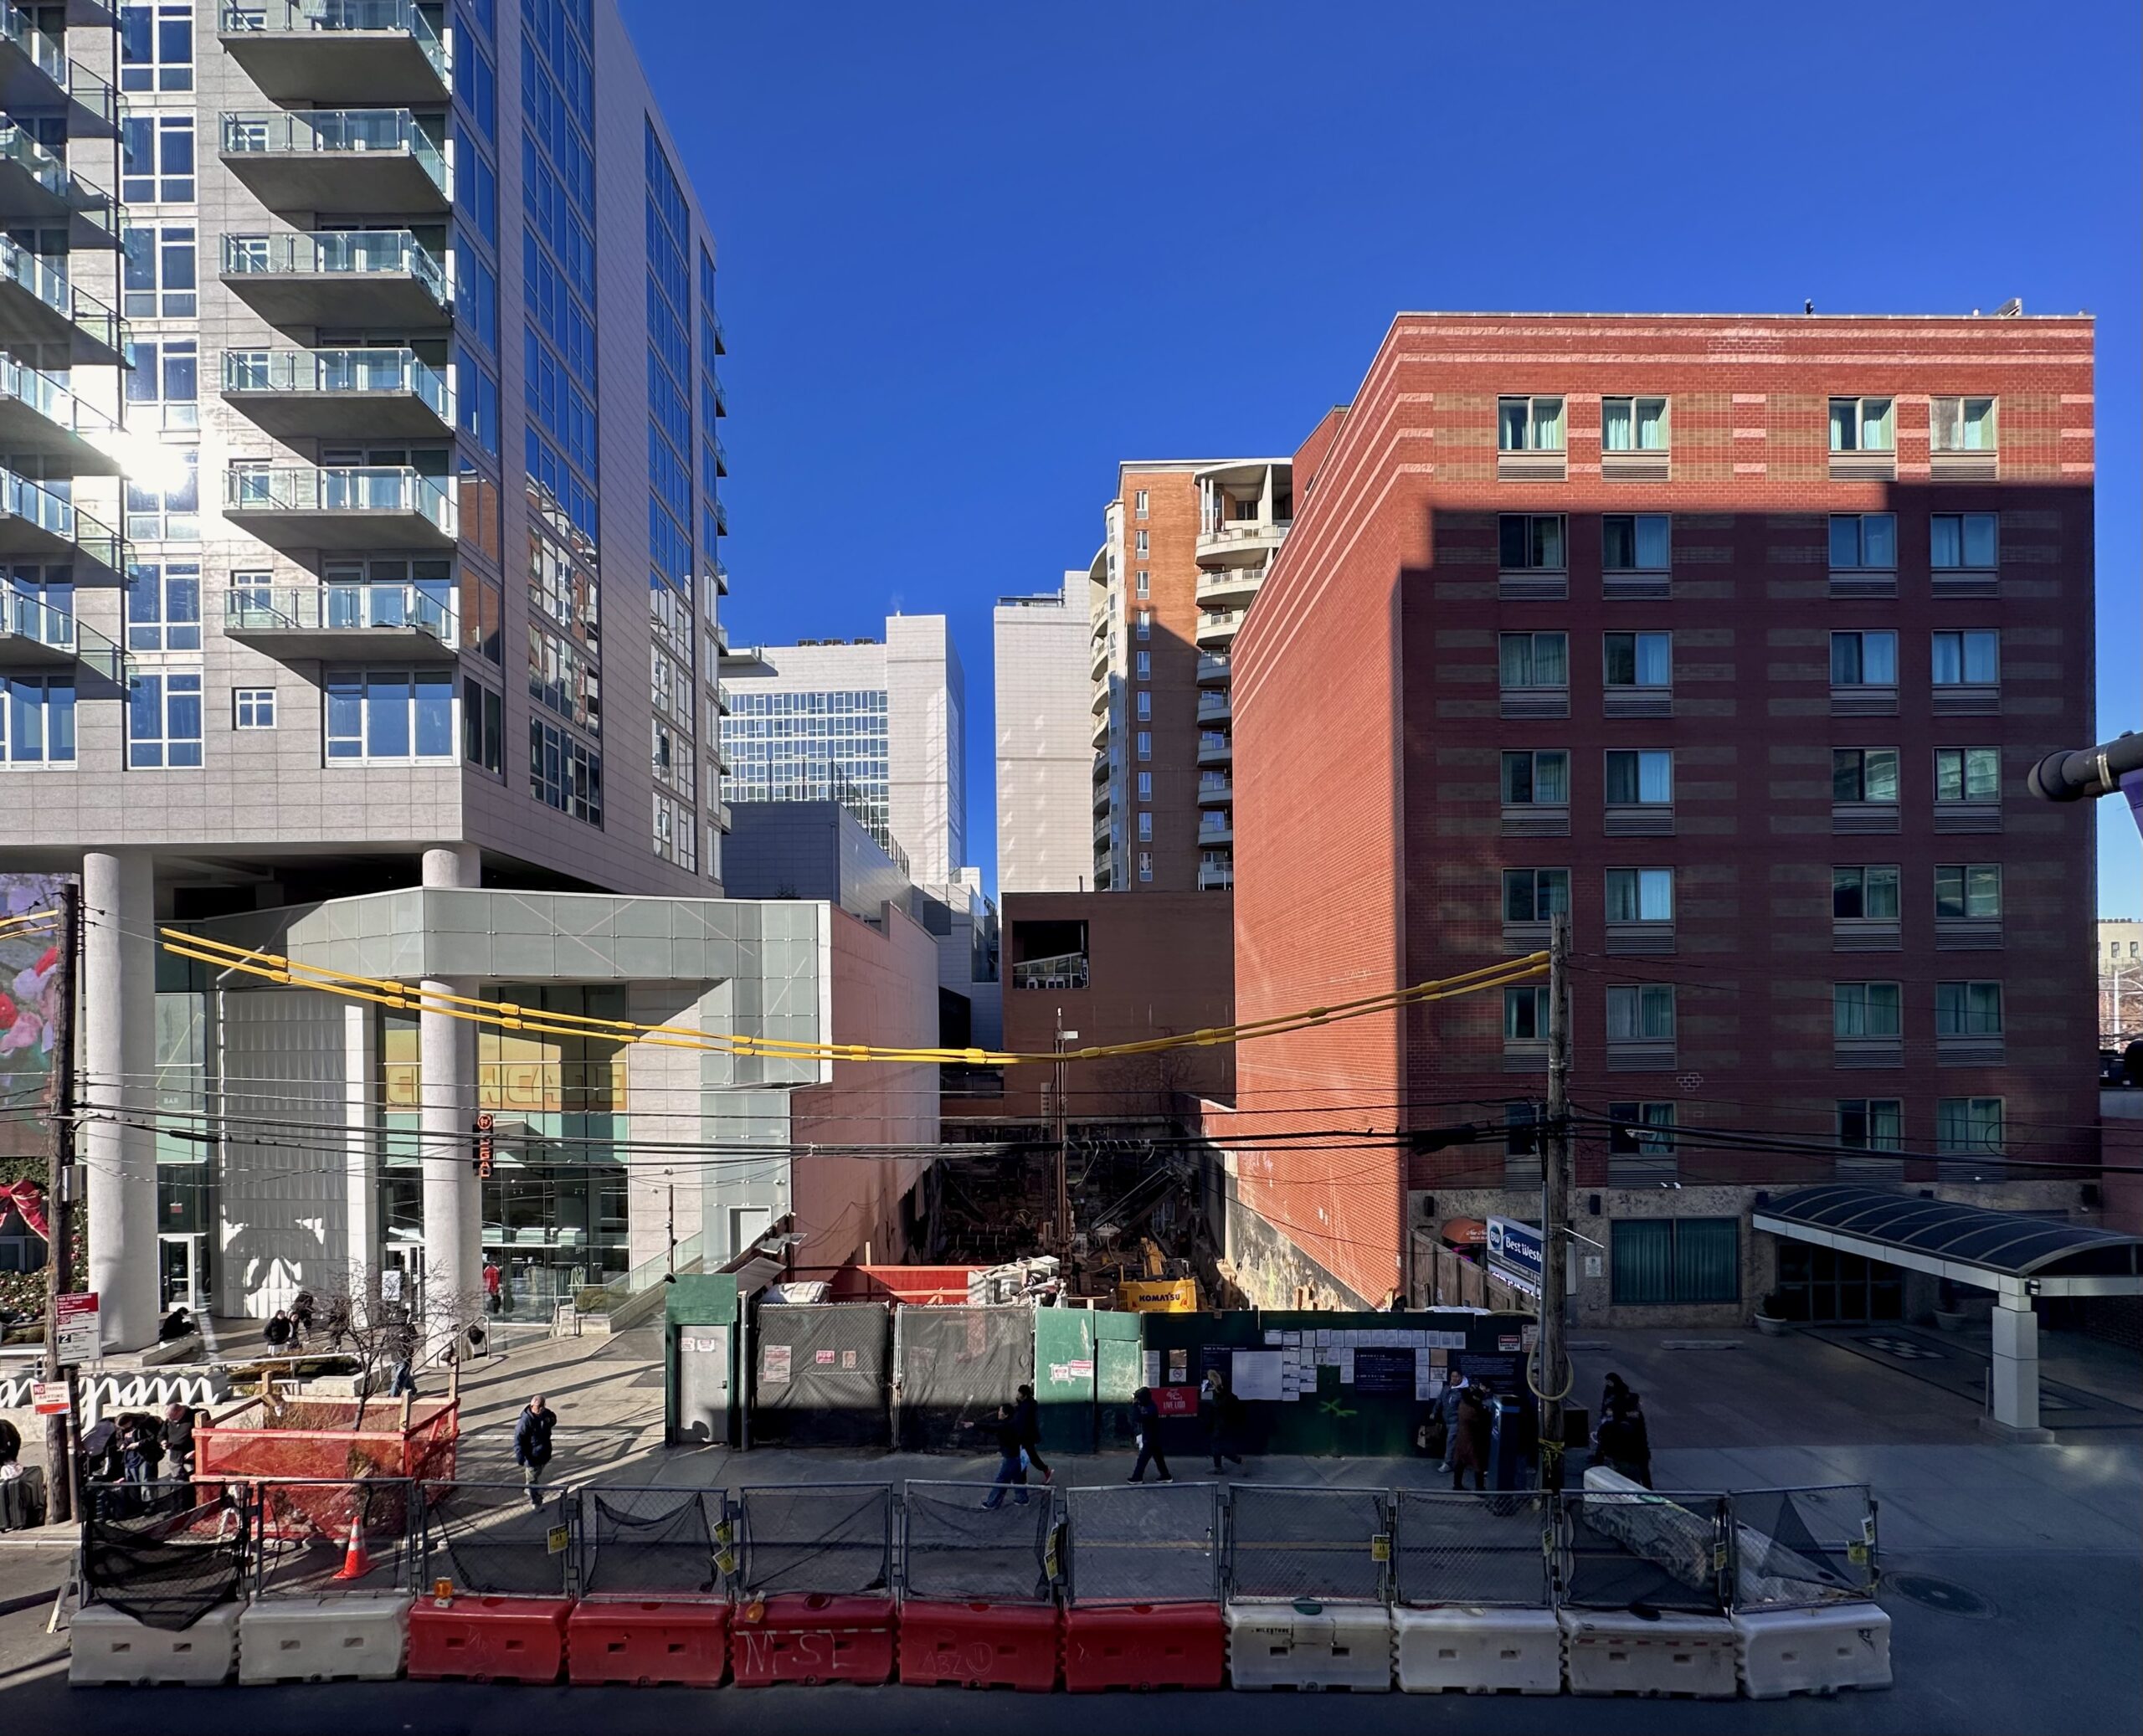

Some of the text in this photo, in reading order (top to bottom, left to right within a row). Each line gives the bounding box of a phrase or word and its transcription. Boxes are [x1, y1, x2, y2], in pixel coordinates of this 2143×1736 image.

[387, 1065, 624, 1104] CWCADE
[1505, 1235, 1522, 1254] Best
[1138, 1292, 1180, 1302] KOMATSU
[61, 1334, 68, 1343] 2
[33, 1385, 45, 1394] NO
